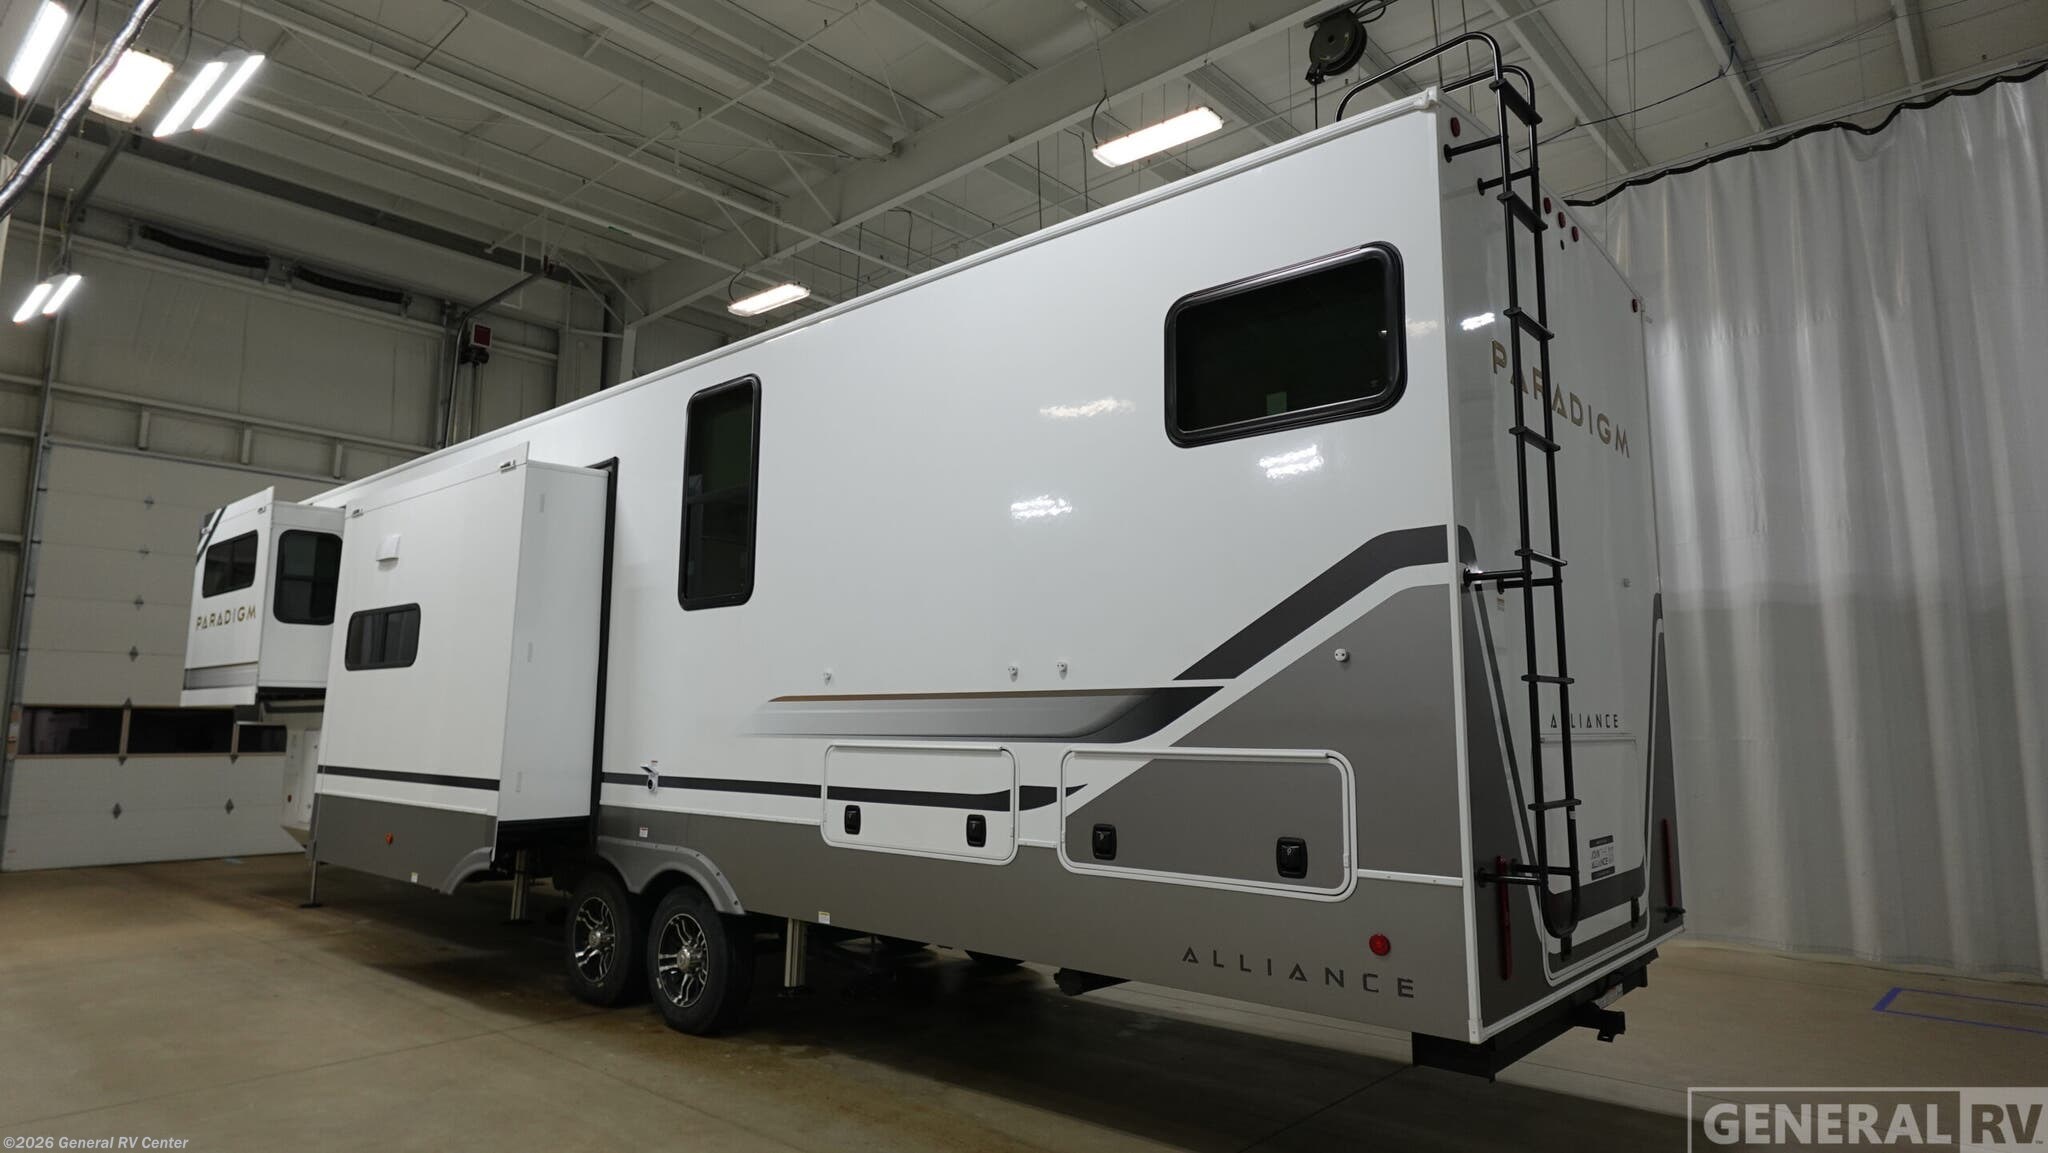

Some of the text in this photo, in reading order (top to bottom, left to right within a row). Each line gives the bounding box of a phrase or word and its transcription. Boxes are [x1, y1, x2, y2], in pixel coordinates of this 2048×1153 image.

[196, 605, 256, 630] PARADIGM
[1550, 712, 1619, 729] ALIANCE
[1182, 946, 1414, 999] ALLIANCE
